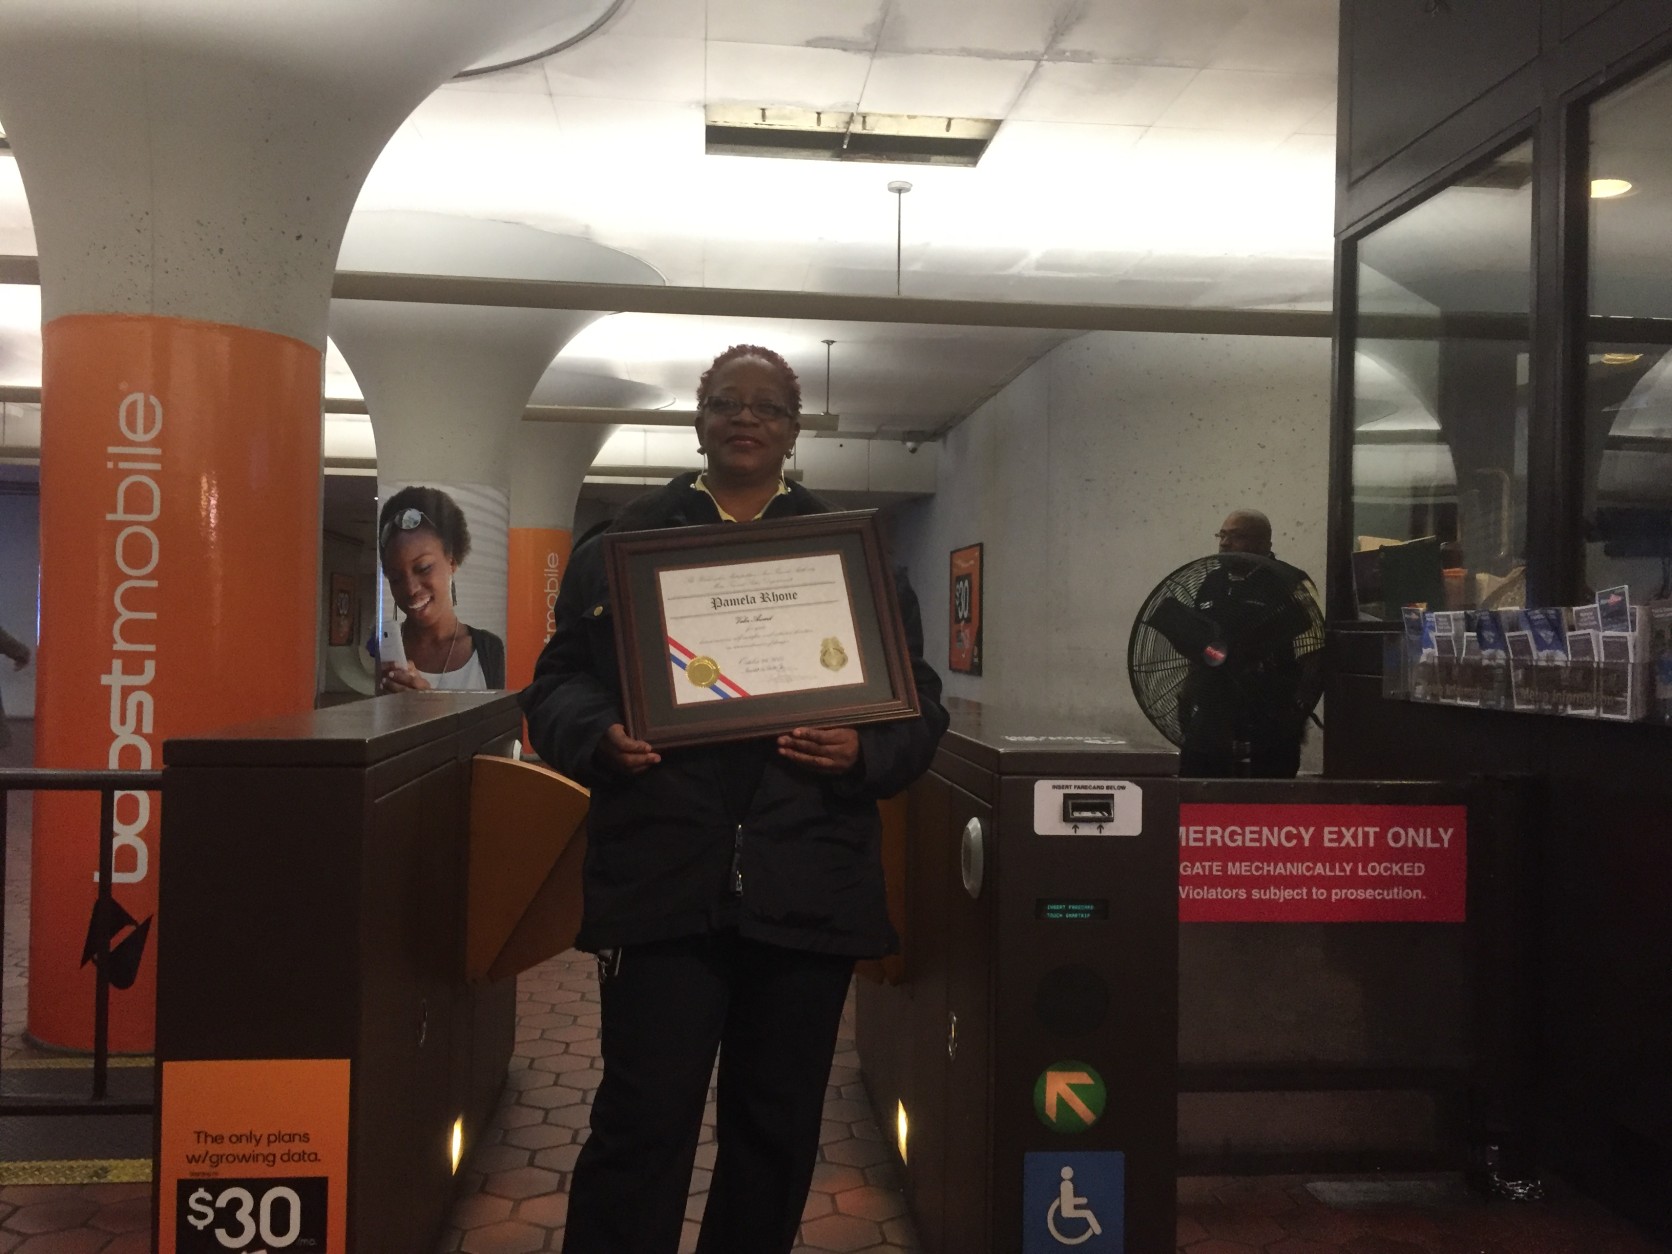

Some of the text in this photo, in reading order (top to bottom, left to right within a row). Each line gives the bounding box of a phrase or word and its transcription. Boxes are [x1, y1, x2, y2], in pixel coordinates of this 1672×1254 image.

[710, 590, 798, 610] Pamela Rhone
[1324, 827, 1380, 848] EXIT
[1387, 827, 1455, 849] ONLY
[1180, 862, 1426, 876] GATE MECHANICALLY LOCKED
[1179, 885, 1427, 902] Violators subject to prosecution.
[193, 1130, 310, 1146] The only plans
[186, 1149, 322, 1168] w/growing data.
[187, 1185, 301, 1248] $30
